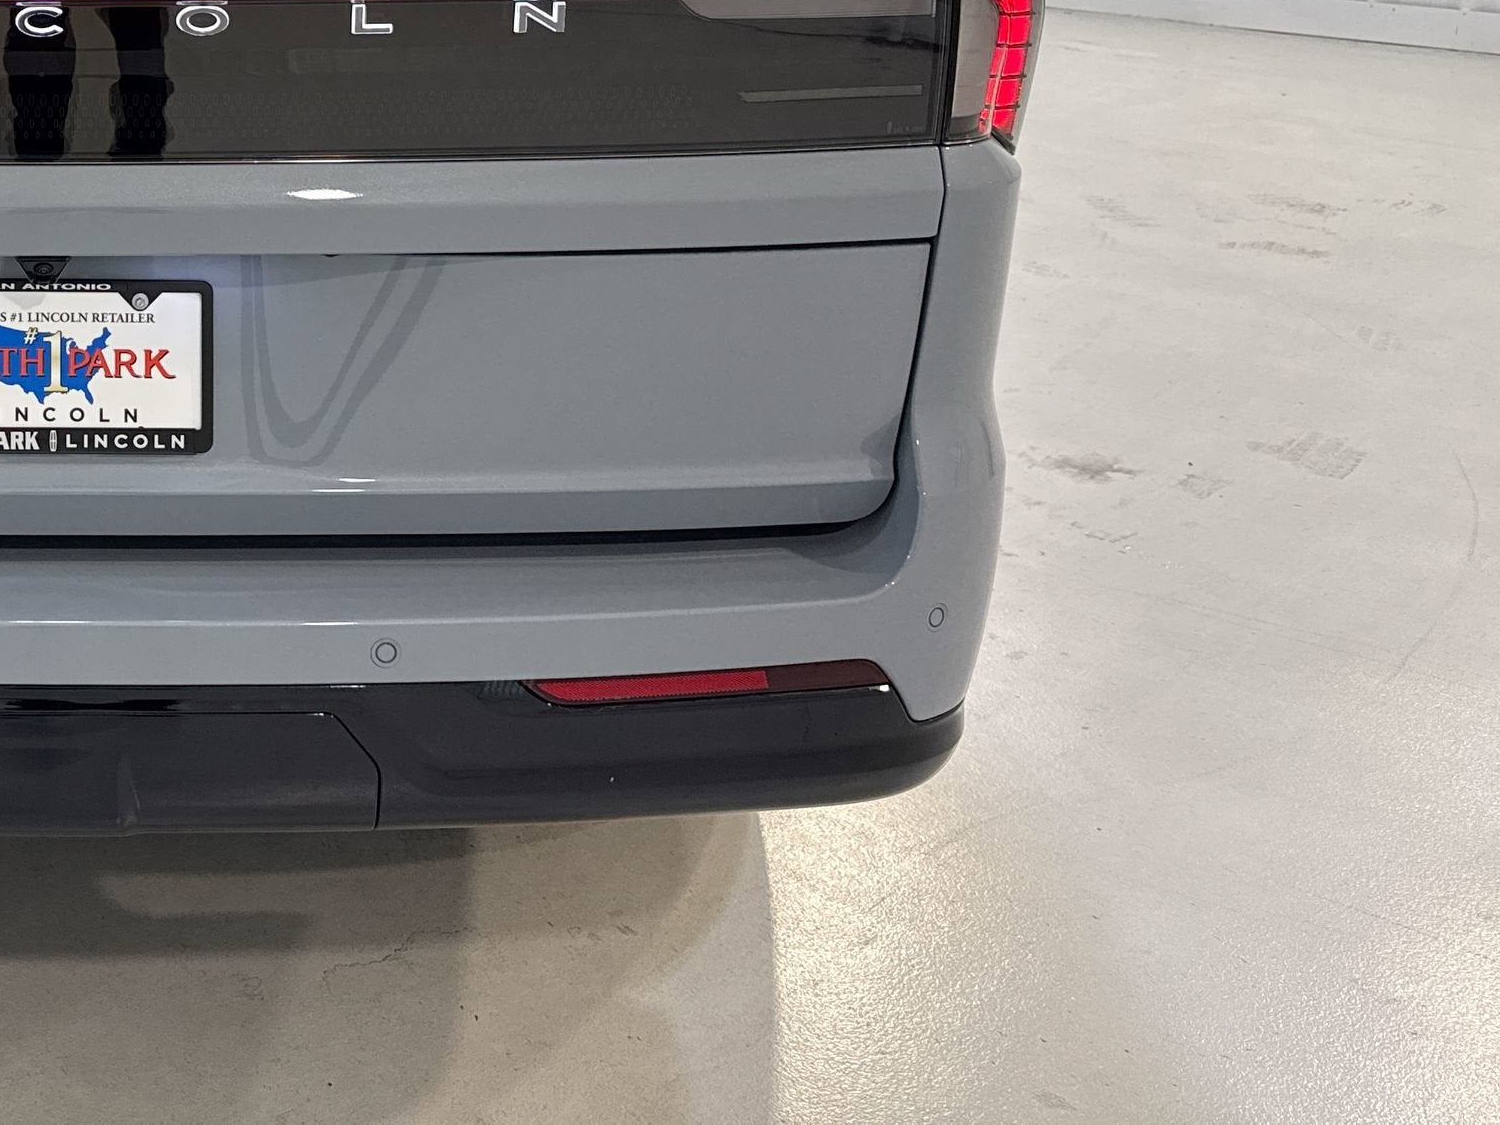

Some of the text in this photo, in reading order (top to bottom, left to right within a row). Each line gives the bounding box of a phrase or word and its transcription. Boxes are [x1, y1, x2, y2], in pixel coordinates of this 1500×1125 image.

[21, 282, 112, 291] ANTONIO
[10, 312, 23, 323] #1
[27, 312, 88, 324] LINCOLN
[91, 312, 156, 324] RETAILER
[67, 347, 177, 379] PARK
[65, 433, 186, 451] LINCOLN
